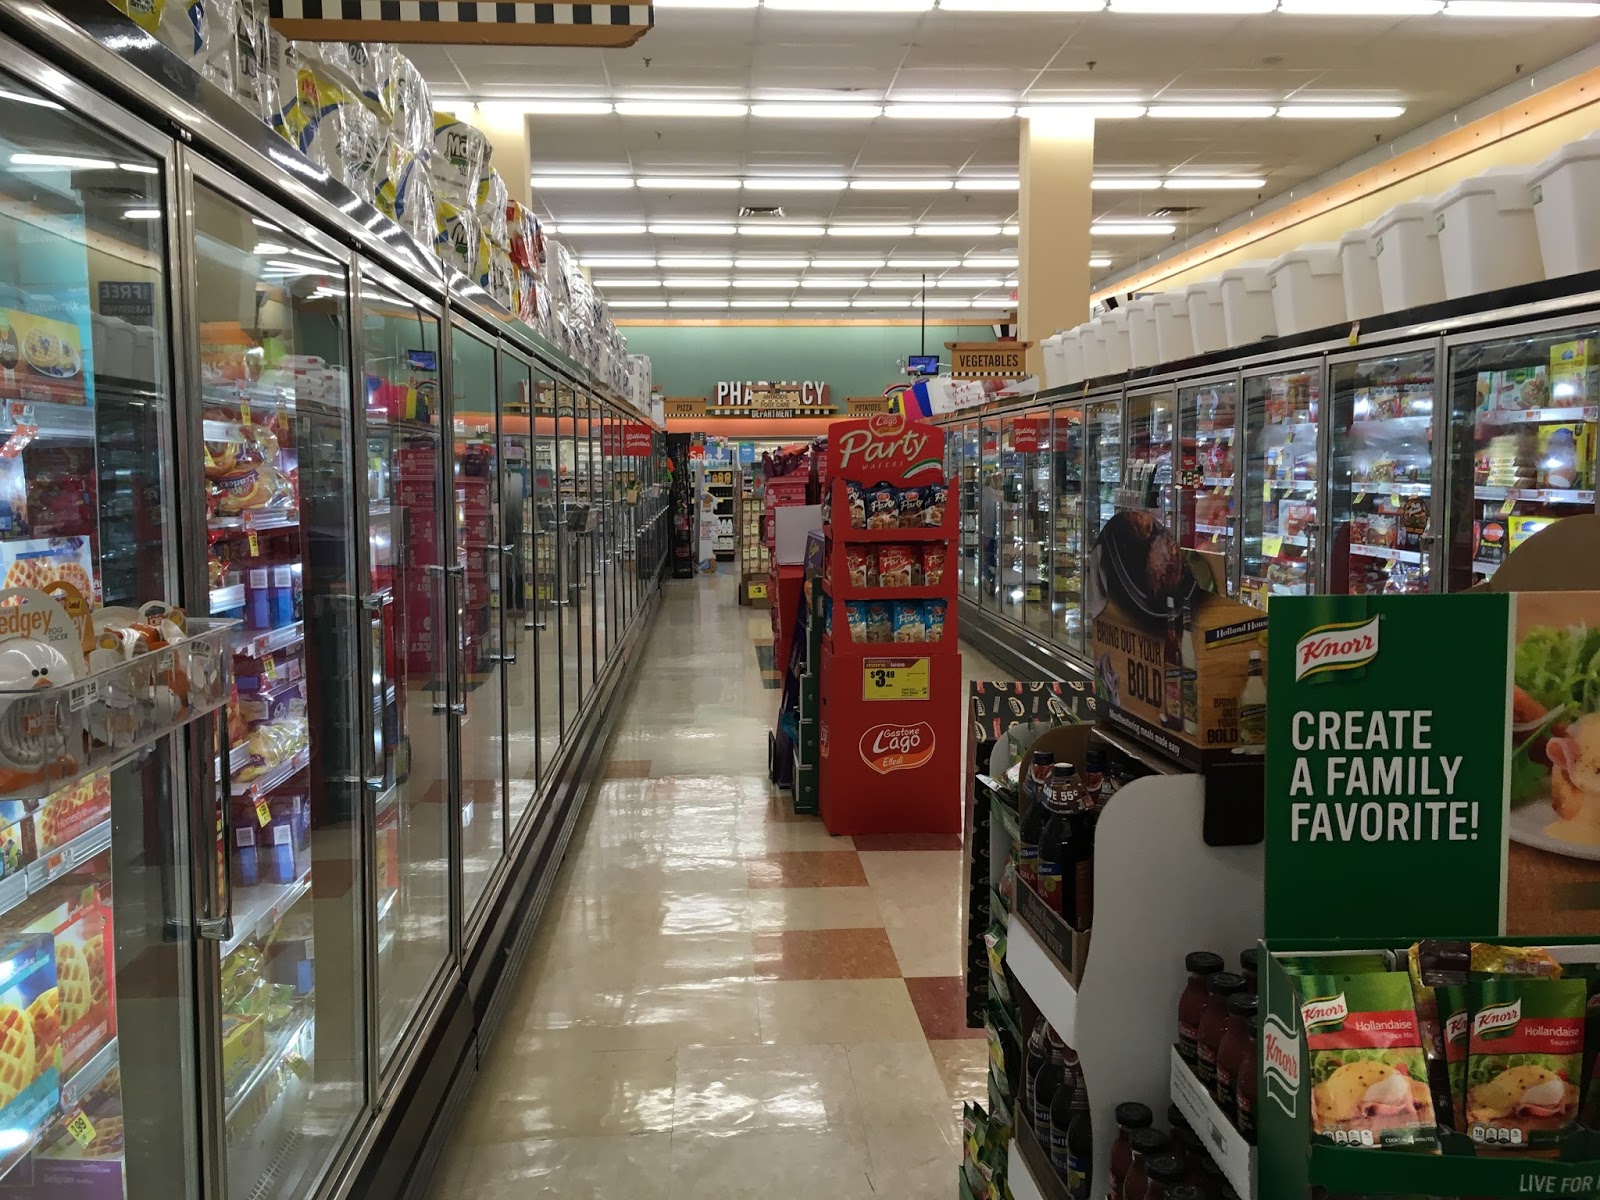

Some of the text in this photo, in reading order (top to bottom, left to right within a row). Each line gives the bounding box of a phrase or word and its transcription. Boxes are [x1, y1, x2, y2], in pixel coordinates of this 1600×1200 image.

[959, 354, 1018, 367] VEGETABLES
[717, 381, 825, 405] PHACY
[752, 409, 793, 418] DEPARTMENT
[855, 404, 881, 412] POTATOES
[690, 450, 713, 460] Sale
[840, 430, 928, 468] Party
[862, 461, 904, 470] WAFERS
[871, 500, 895, 512] Party
[1216, 619, 1269, 638] Holland Hous
[48, 633, 68, 642] SLICER
[1096, 620, 1162, 667] BRING OUT YOUR
[1300, 634, 1375, 665] Knorr
[1127, 657, 1163, 709] BOLD
[1213, 698, 1238, 708] BRING
[1222, 708, 1238, 717] OUT
[1217, 718, 1238, 727] YOUR
[1292, 710, 1433, 751] CREATE
[883, 727, 920, 738] Gastone
[1207, 729, 1238, 743] BOLD
[872, 730, 920, 753] Lago
[1140, 727, 1154, 741] meals
[1154, 734, 1168, 748] made
[1168, 741, 1180, 757] easy
[882, 756, 904, 767] Elledi
[1289, 756, 1463, 796] A FAMILY
[1042, 783, 1058, 800] SAVE
[57, 808, 88, 829] Homestyle
[1291, 801, 1479, 842] FAVORITE!
[1303, 1004, 1345, 1023] Knorr
[1478, 1009, 1519, 1027] Knorr
[1355, 1020, 1412, 1031] Hollandaise
[1525, 1025, 1580, 1036] Hollandaise
[1265, 1033, 1298, 1079] Knorr
[71, 1117, 87, 1137] 3.99
[1407, 1135, 1414, 1145] 4
[1519, 1174, 1593, 1193] LIVE FOR
